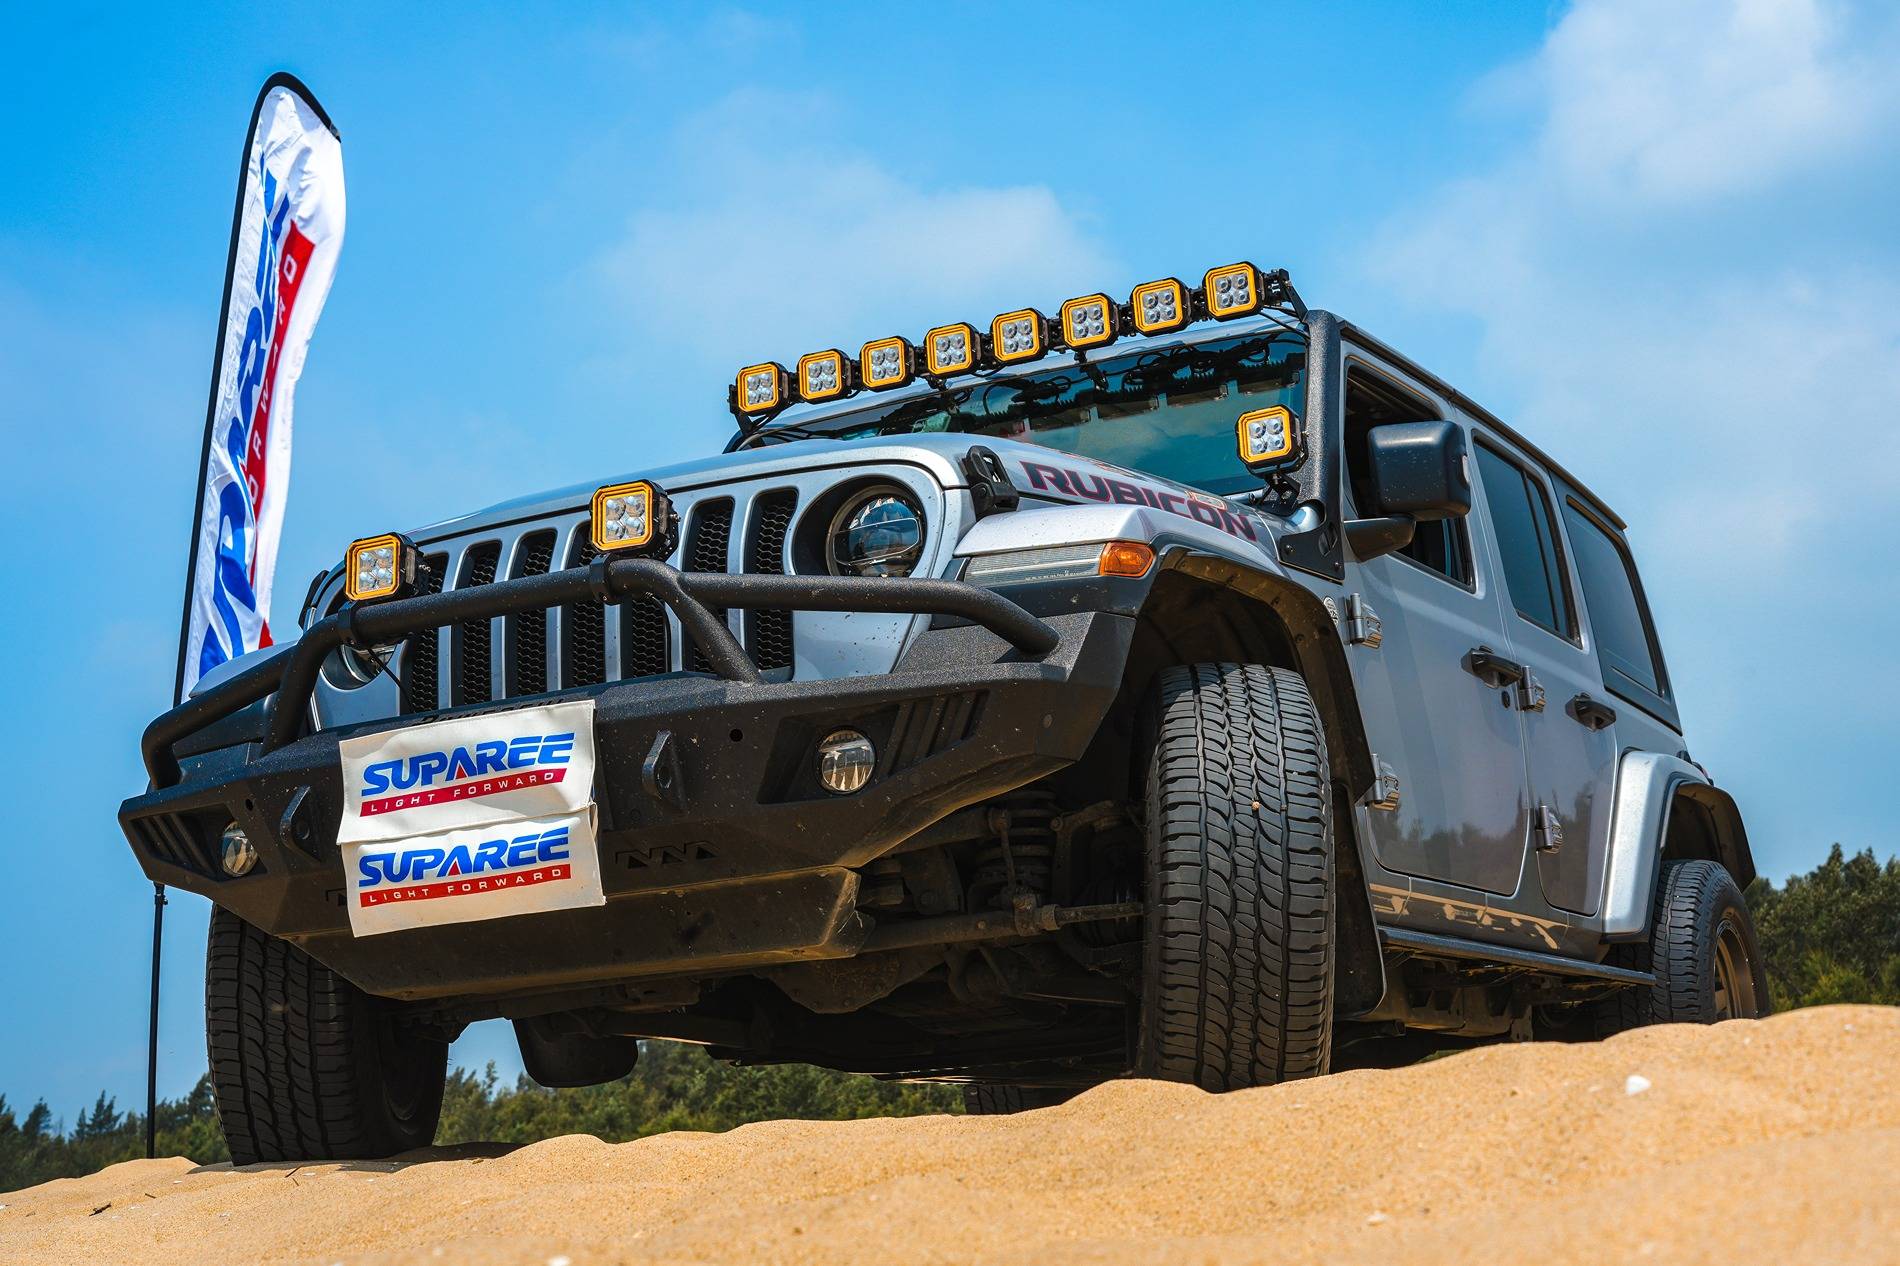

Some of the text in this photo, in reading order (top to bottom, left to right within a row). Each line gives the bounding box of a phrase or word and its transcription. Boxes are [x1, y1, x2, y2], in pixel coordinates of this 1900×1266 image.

[1019, 460, 1258, 542] RUBICON
[361, 732, 575, 797] SUPAREE
[371, 772, 555, 812] LIGHT FORWARD
[358, 826, 570, 888] SUPAREE
[370, 868, 561, 903] LIGHT FORWARD
